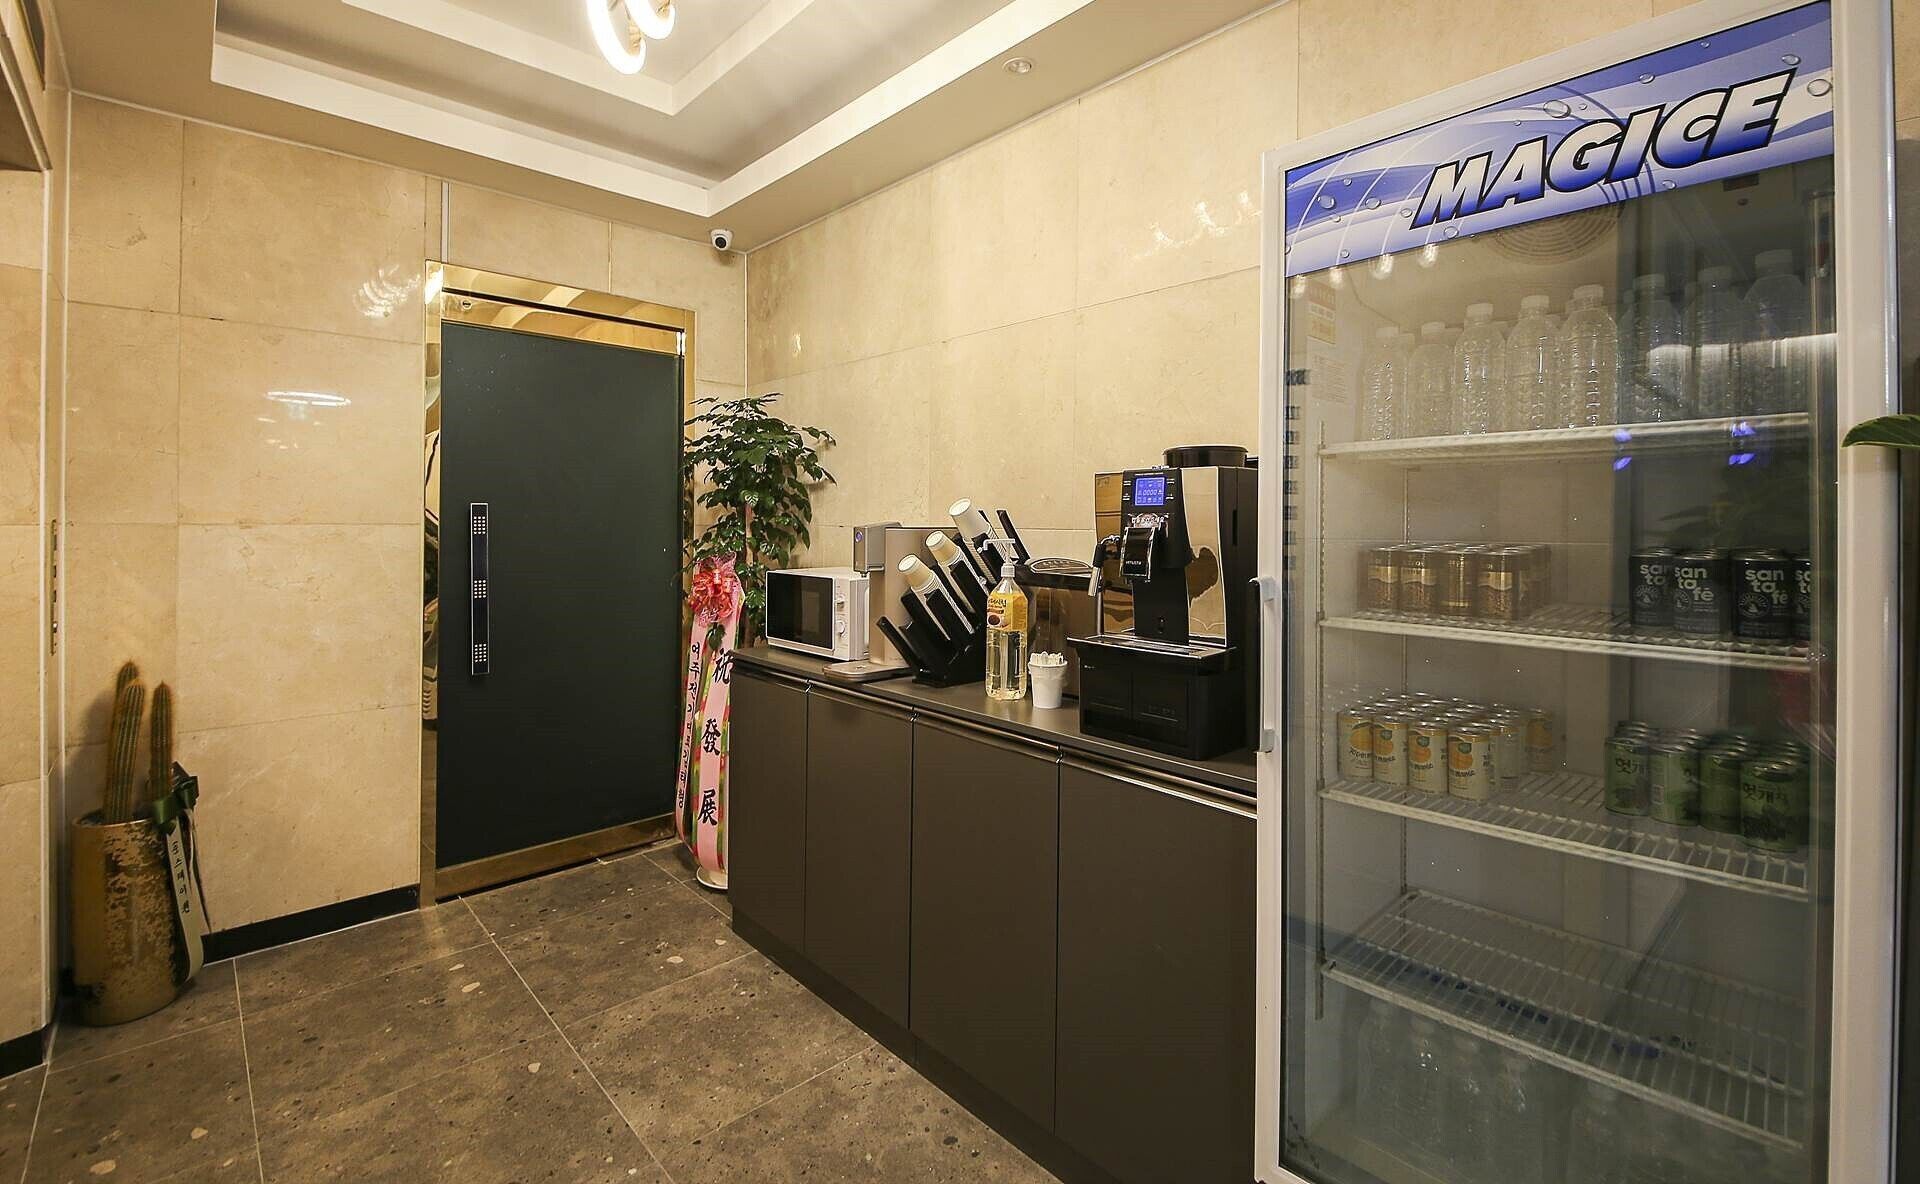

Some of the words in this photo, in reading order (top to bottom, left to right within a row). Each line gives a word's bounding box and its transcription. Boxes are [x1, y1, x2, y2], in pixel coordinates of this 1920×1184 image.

[1409, 67, 1798, 230] MAGICE
[1674, 566, 1708, 579] san
[1744, 568, 1785, 581] san
[1676, 575, 1698, 590] ta
[1750, 578, 1777, 593] ta
[698, 647, 735, 827] 祝發展
